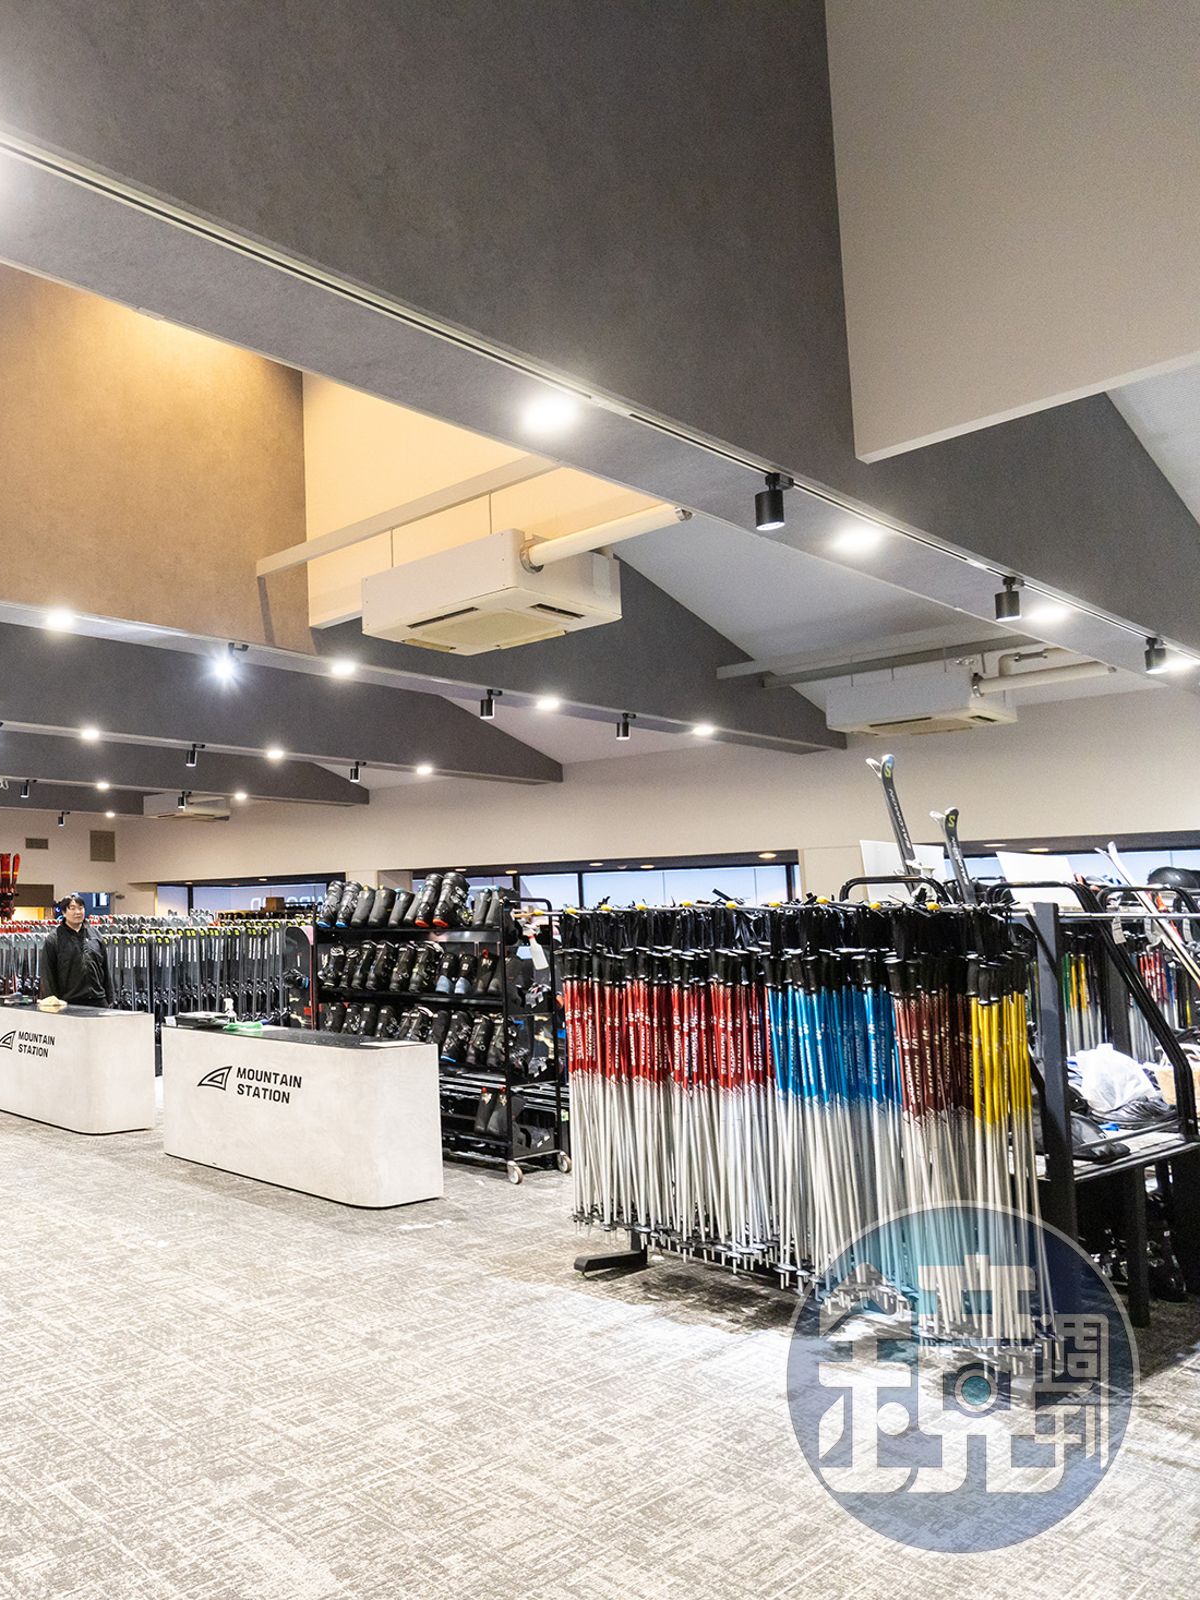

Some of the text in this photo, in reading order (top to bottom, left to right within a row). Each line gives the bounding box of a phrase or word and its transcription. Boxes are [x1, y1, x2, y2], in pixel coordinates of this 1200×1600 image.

[18, 1031, 55, 1046] MOUNTAIN
[18, 1044, 49, 1058] STATION
[236, 1066, 302, 1089] MOUNTAIN
[237, 1083, 290, 1104] STATION
